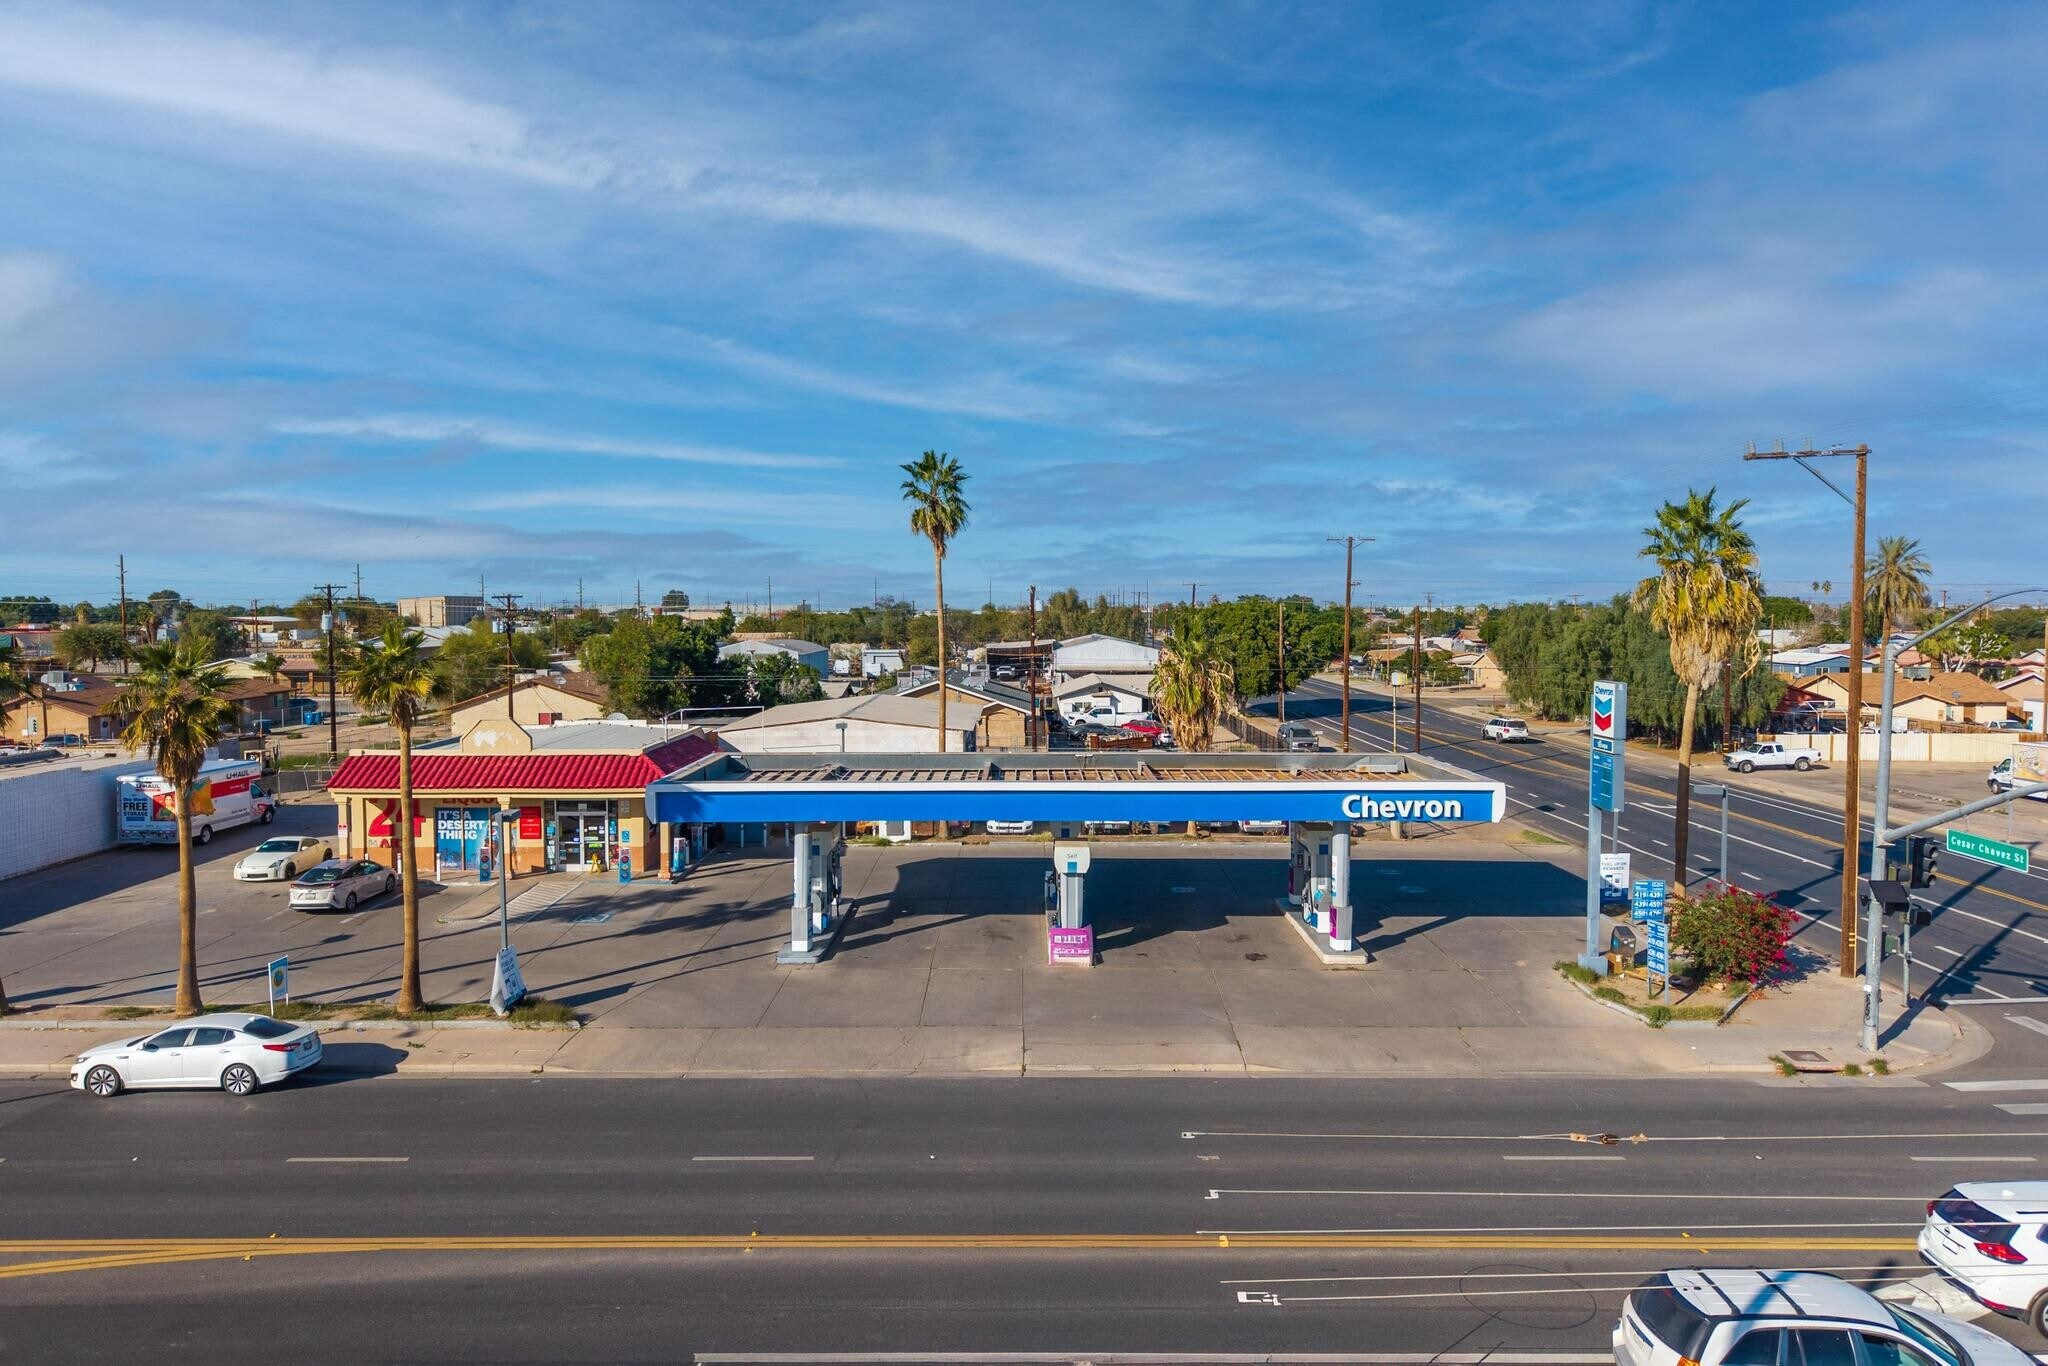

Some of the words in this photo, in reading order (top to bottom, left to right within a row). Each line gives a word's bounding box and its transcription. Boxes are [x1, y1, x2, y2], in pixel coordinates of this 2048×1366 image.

[1595, 686, 1614, 696] Chevron
[123, 802, 148, 811] FREE
[1342, 795, 1462, 819] Chevron
[438, 810, 460, 820] IT'S
[463, 810, 472, 820] A
[438, 820, 485, 830] DESERT
[438, 830, 478, 839] THING
[1951, 836, 1976, 850] Cesar
[1978, 843, 2011, 860] Chavez
[2014, 853, 2024, 864] St
